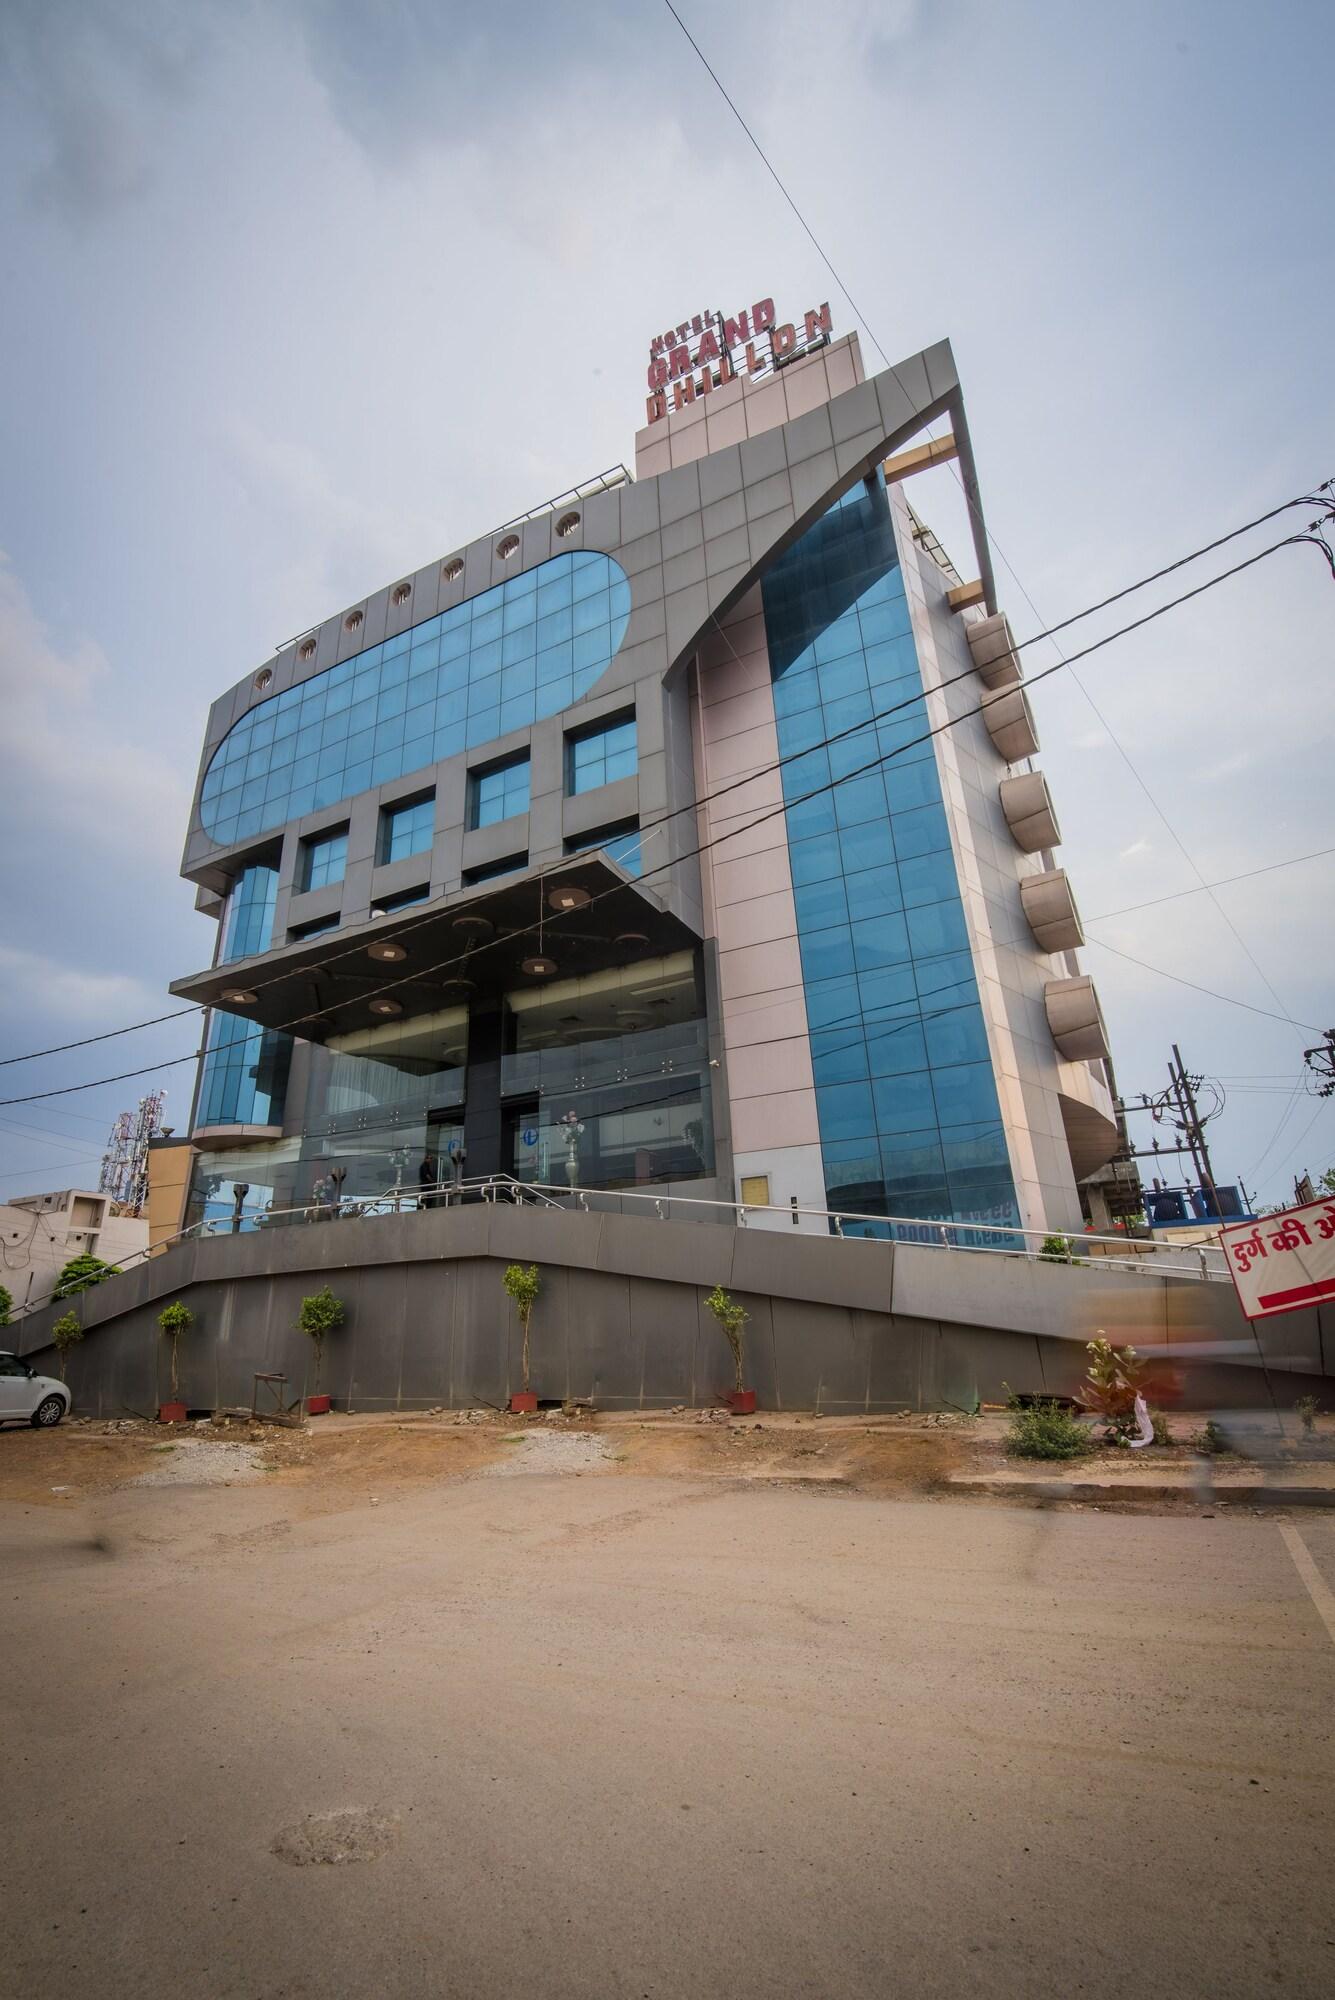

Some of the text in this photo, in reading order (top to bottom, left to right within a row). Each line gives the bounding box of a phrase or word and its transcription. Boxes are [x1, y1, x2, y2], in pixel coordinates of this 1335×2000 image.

[646, 301, 834, 425] DHILLON
[648, 298, 777, 391] GRAND
[651, 309, 716, 355] HOTEL
[1231, 1228, 1268, 1272] दुर्ग
[1266, 1218, 1312, 1251] की
